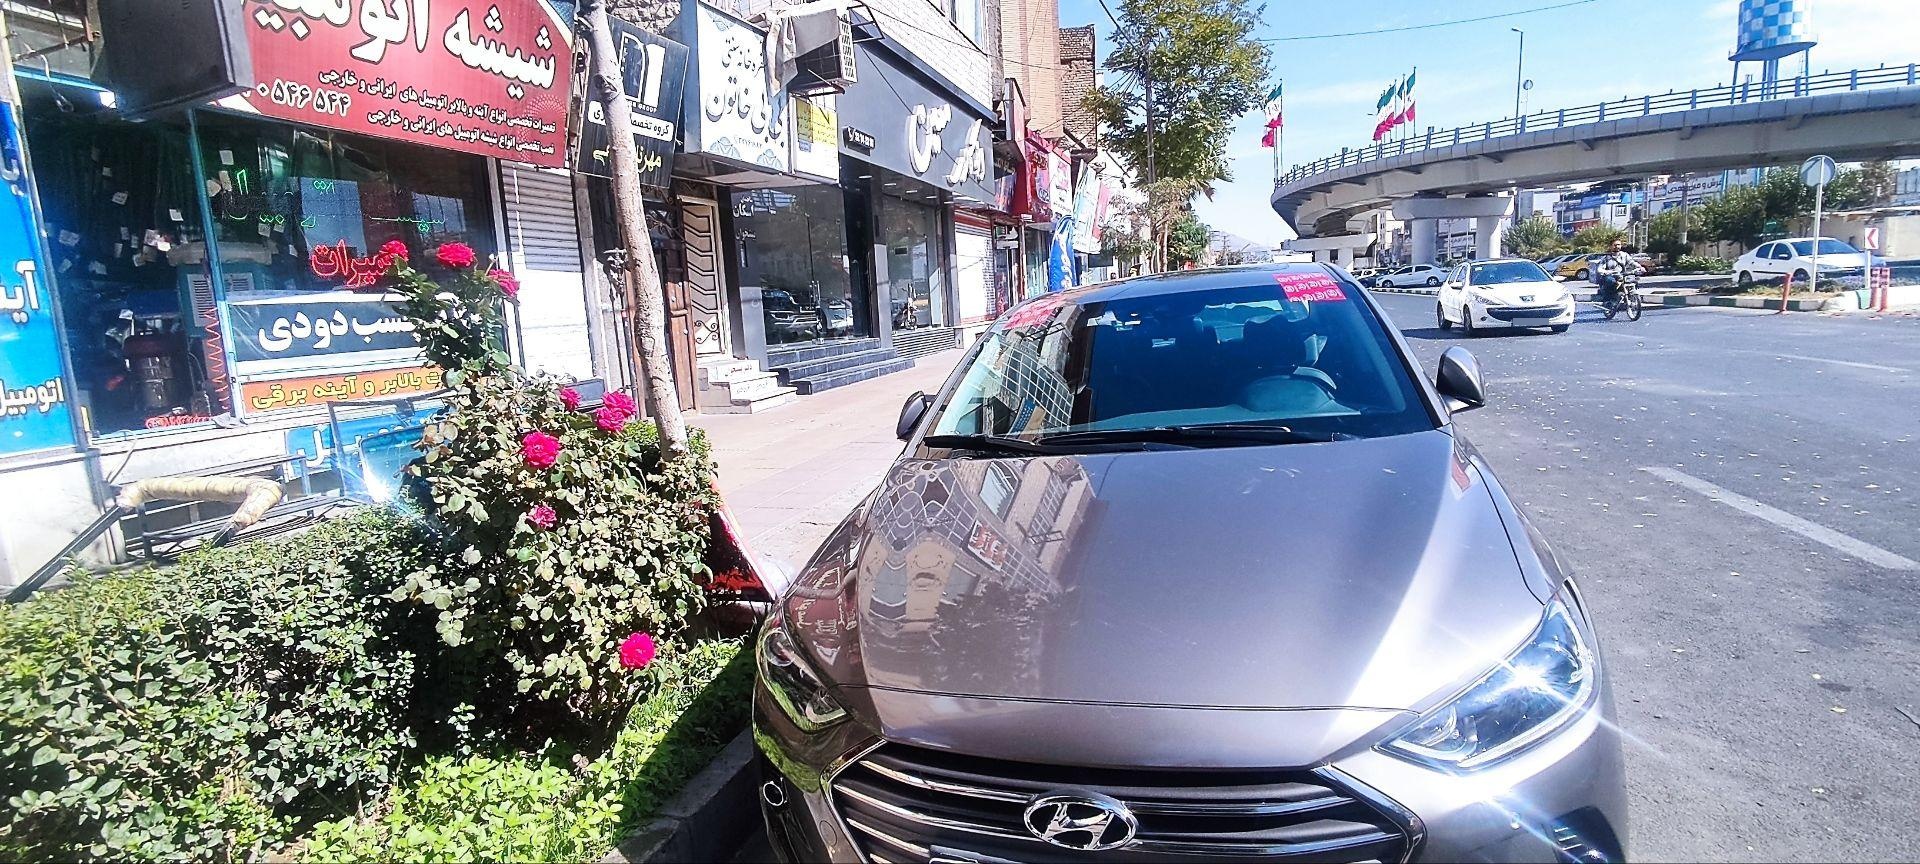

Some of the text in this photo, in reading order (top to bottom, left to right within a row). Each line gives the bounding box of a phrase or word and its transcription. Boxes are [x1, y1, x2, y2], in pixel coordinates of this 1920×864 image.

[443, 5, 556, 99] شیشه
[318, 69, 358, 88] خارجی
[358, 80, 366, 93] و
[367, 78, 397, 98] ایرانی
[399, 86, 418, 102] های
[418, 90, 448, 110] اتومبیل
[448, 98, 467, 116] بالابر
[474, 104, 489, 119] آینه
[489, 108, 507, 124] انواع
[507, 116, 533, 126] تخصصی
[533, 119, 556, 133] تعمیرات
[631, 118, 670, 136] گروه تخصص
[367, 110, 555, 154] نصب تخصصی انواع شیشه اتومبیل های ایرانی و خارجی
[258, 308, 352, 352] دودی
[312, 375, 358, 400] آینه
[363, 380, 376, 396] و
[380, 372, 421, 394] بالابر
[252, 383, 308, 410] برقی
